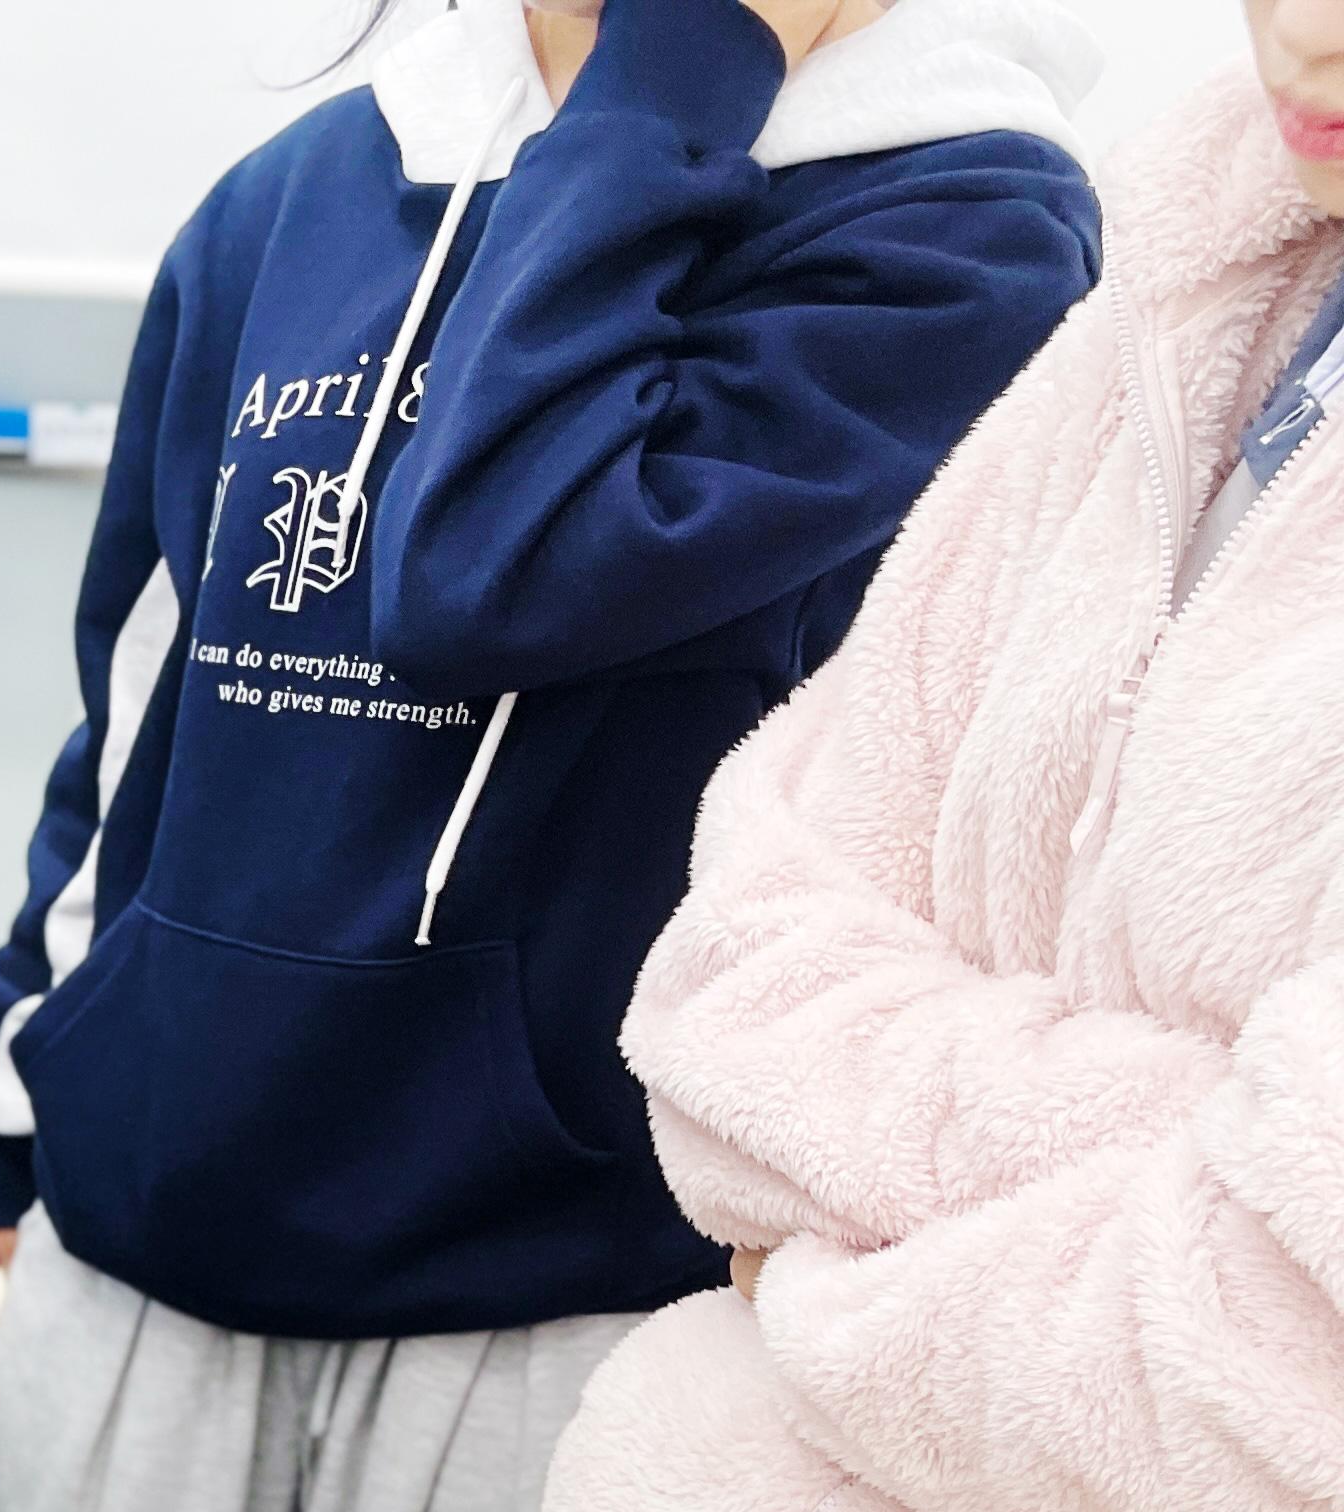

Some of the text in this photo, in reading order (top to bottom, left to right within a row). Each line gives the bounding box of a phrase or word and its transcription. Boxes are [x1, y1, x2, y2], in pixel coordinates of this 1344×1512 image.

[198, 645, 229, 664] can
[235, 643, 263, 669] do
[269, 652, 384, 686] everything
[218, 680, 477, 729] who gives me strength.
